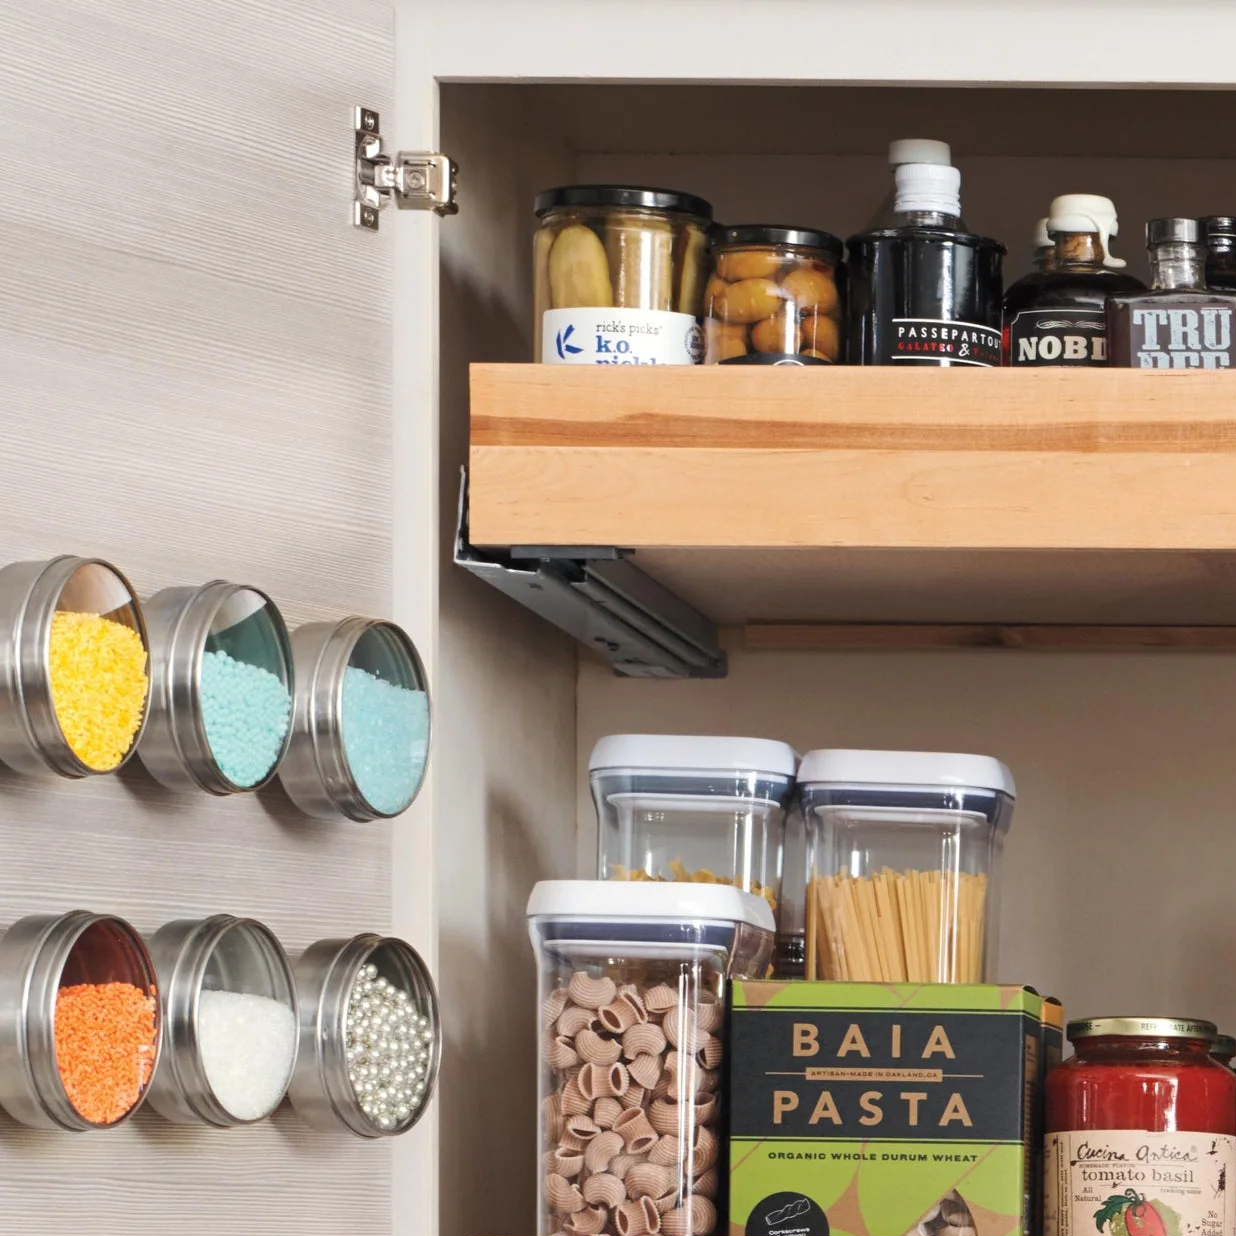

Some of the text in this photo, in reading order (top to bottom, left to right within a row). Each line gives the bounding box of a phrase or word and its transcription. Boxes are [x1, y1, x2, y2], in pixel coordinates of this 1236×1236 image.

[596, 321, 626, 333] rick's
[596, 335, 633, 353] k.o.
[958, 343, 970, 357] &
[792, 1023, 956, 1059] BAIA
[773, 1090, 973, 1127] PASTA
[768, 1152, 979, 1162] ORGANIC WHOLE DURUM WHEAT
[1077, 1141, 1129, 1162] Cucina
[1082, 1168, 1194, 1183] tomato basil
[1208, 1210, 1218, 1218] No
[1201, 1218, 1222, 1229] Sugar
